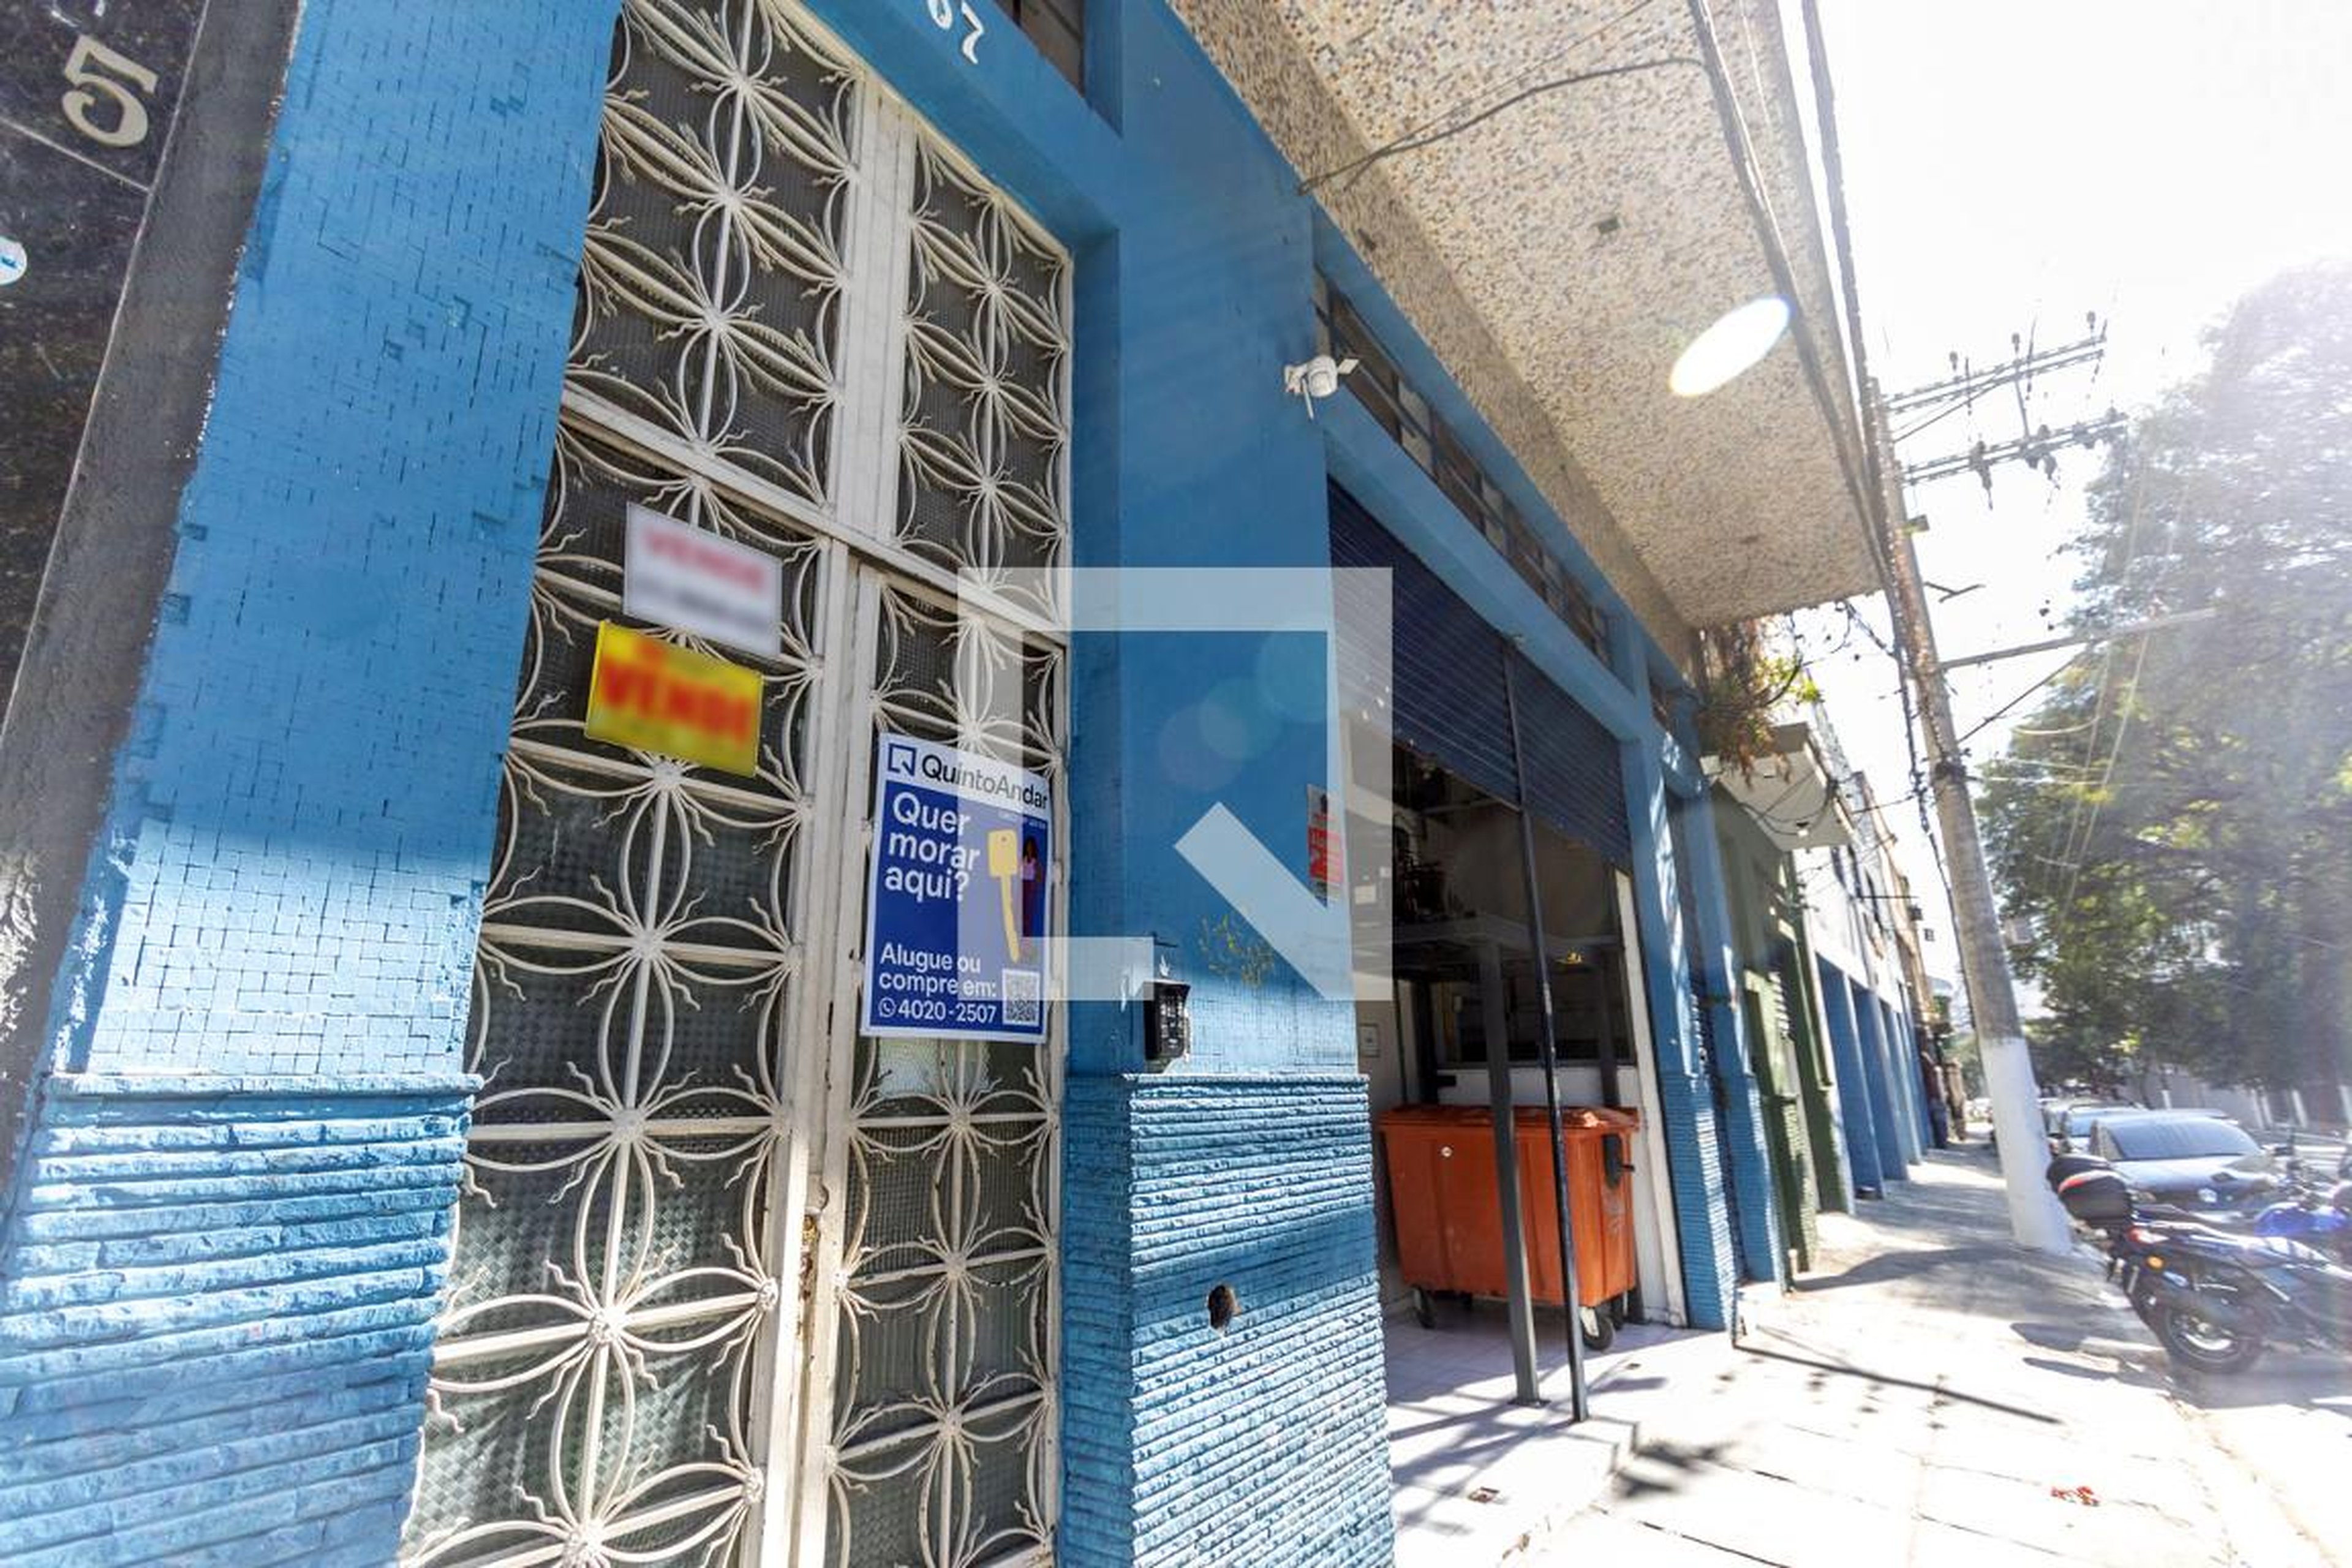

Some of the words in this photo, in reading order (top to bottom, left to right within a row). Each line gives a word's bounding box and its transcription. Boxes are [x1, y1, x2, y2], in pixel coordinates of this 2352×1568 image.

[62, 34, 159, 146] 5
[922, 754, 1047, 809] QuintoAndar
[893, 792, 970, 835] Quer
[889, 832, 980, 871] morar
[885, 867, 970, 902] aqui?
[880, 942, 952, 973] Alugue
[957, 956, 981, 974] ou
[878, 973, 958, 997] compre
[962, 979, 997, 997] em:
[898, 999, 997, 1023] 4020-2507
